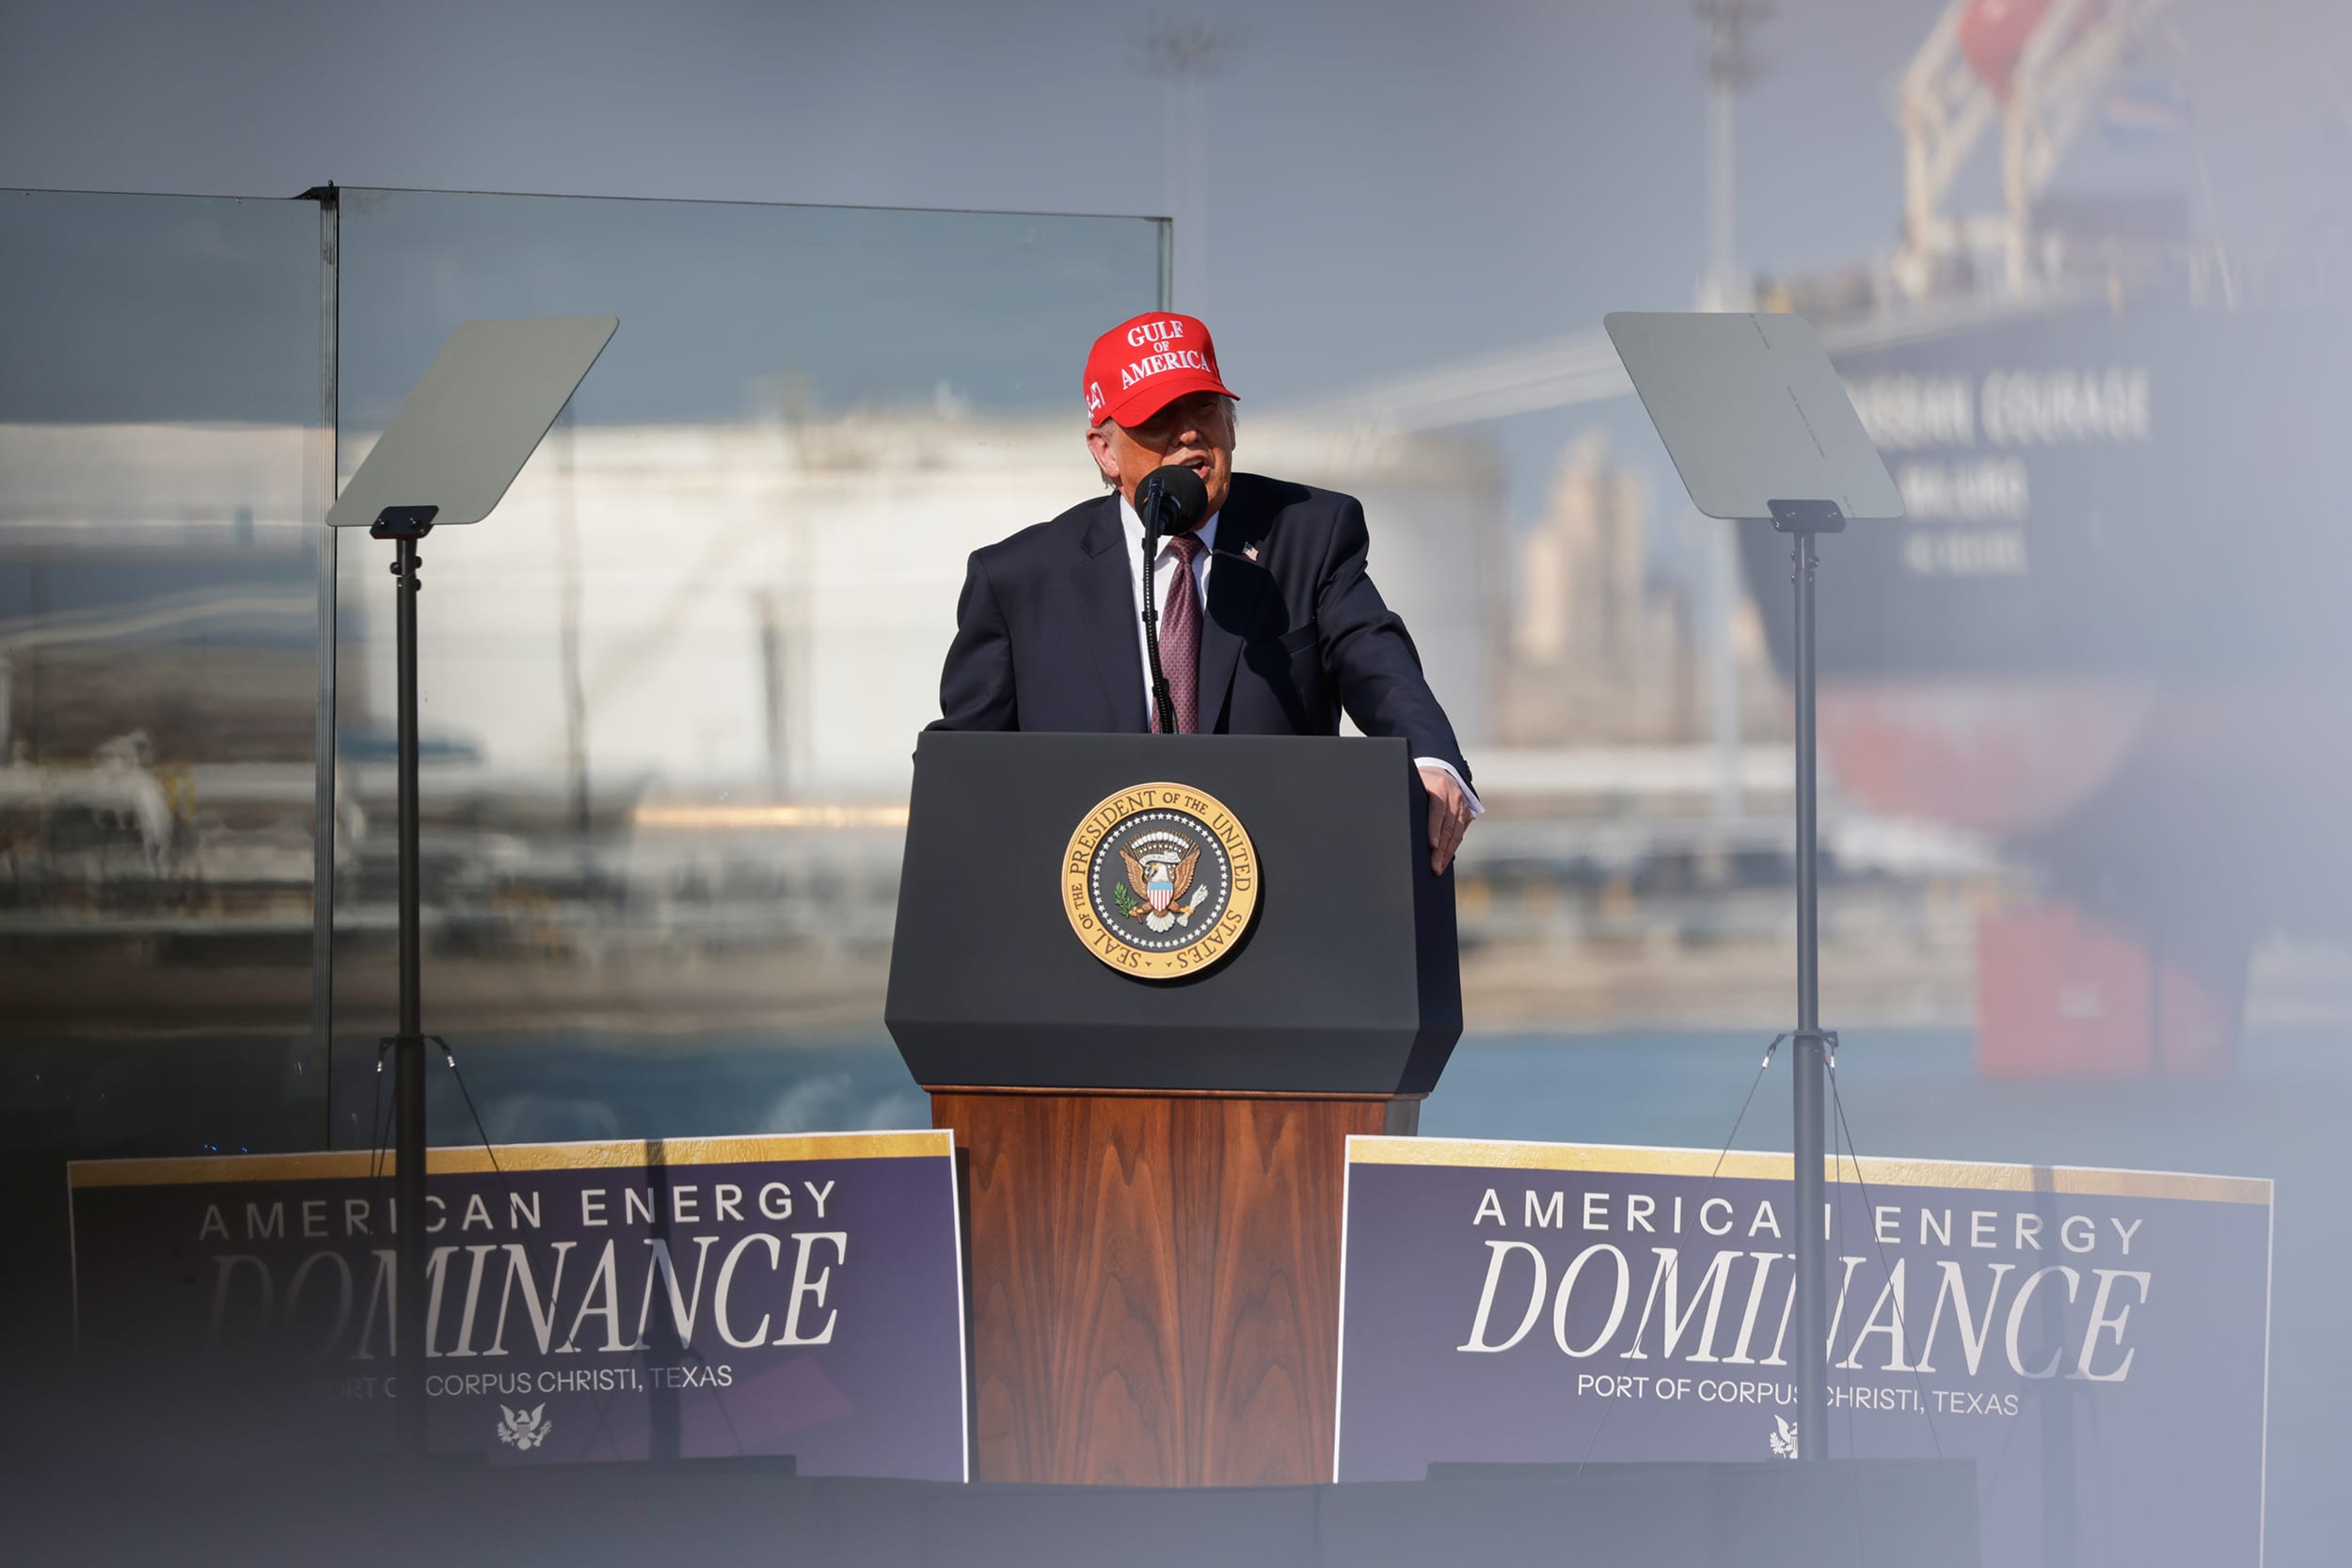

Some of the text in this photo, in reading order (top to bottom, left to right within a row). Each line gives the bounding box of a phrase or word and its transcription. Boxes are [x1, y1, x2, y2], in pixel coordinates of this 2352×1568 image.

[1127, 320, 1184, 347] GULF
[1153, 341, 1169, 353] OF
[1120, 350, 1211, 390] AMERICA
[1070, 790, 1251, 969] SEAL OF THE PRESIDENT OF THE UNITED STATES
[199, 1180, 835, 1241] AMERICAN ENERGY
[1472, 1188, 2143, 1256] AMERICA ENERGY
[425, 1372, 532, 1397] CORPUS
[537, 1368, 644, 1393] CHRISTI,
[649, 1365, 733, 1389] TEXAS
[1578, 1374, 1649, 1399] PORT
[1655, 1378, 1692, 1401] OF
[1931, 1390, 2019, 1417] TEXAS
